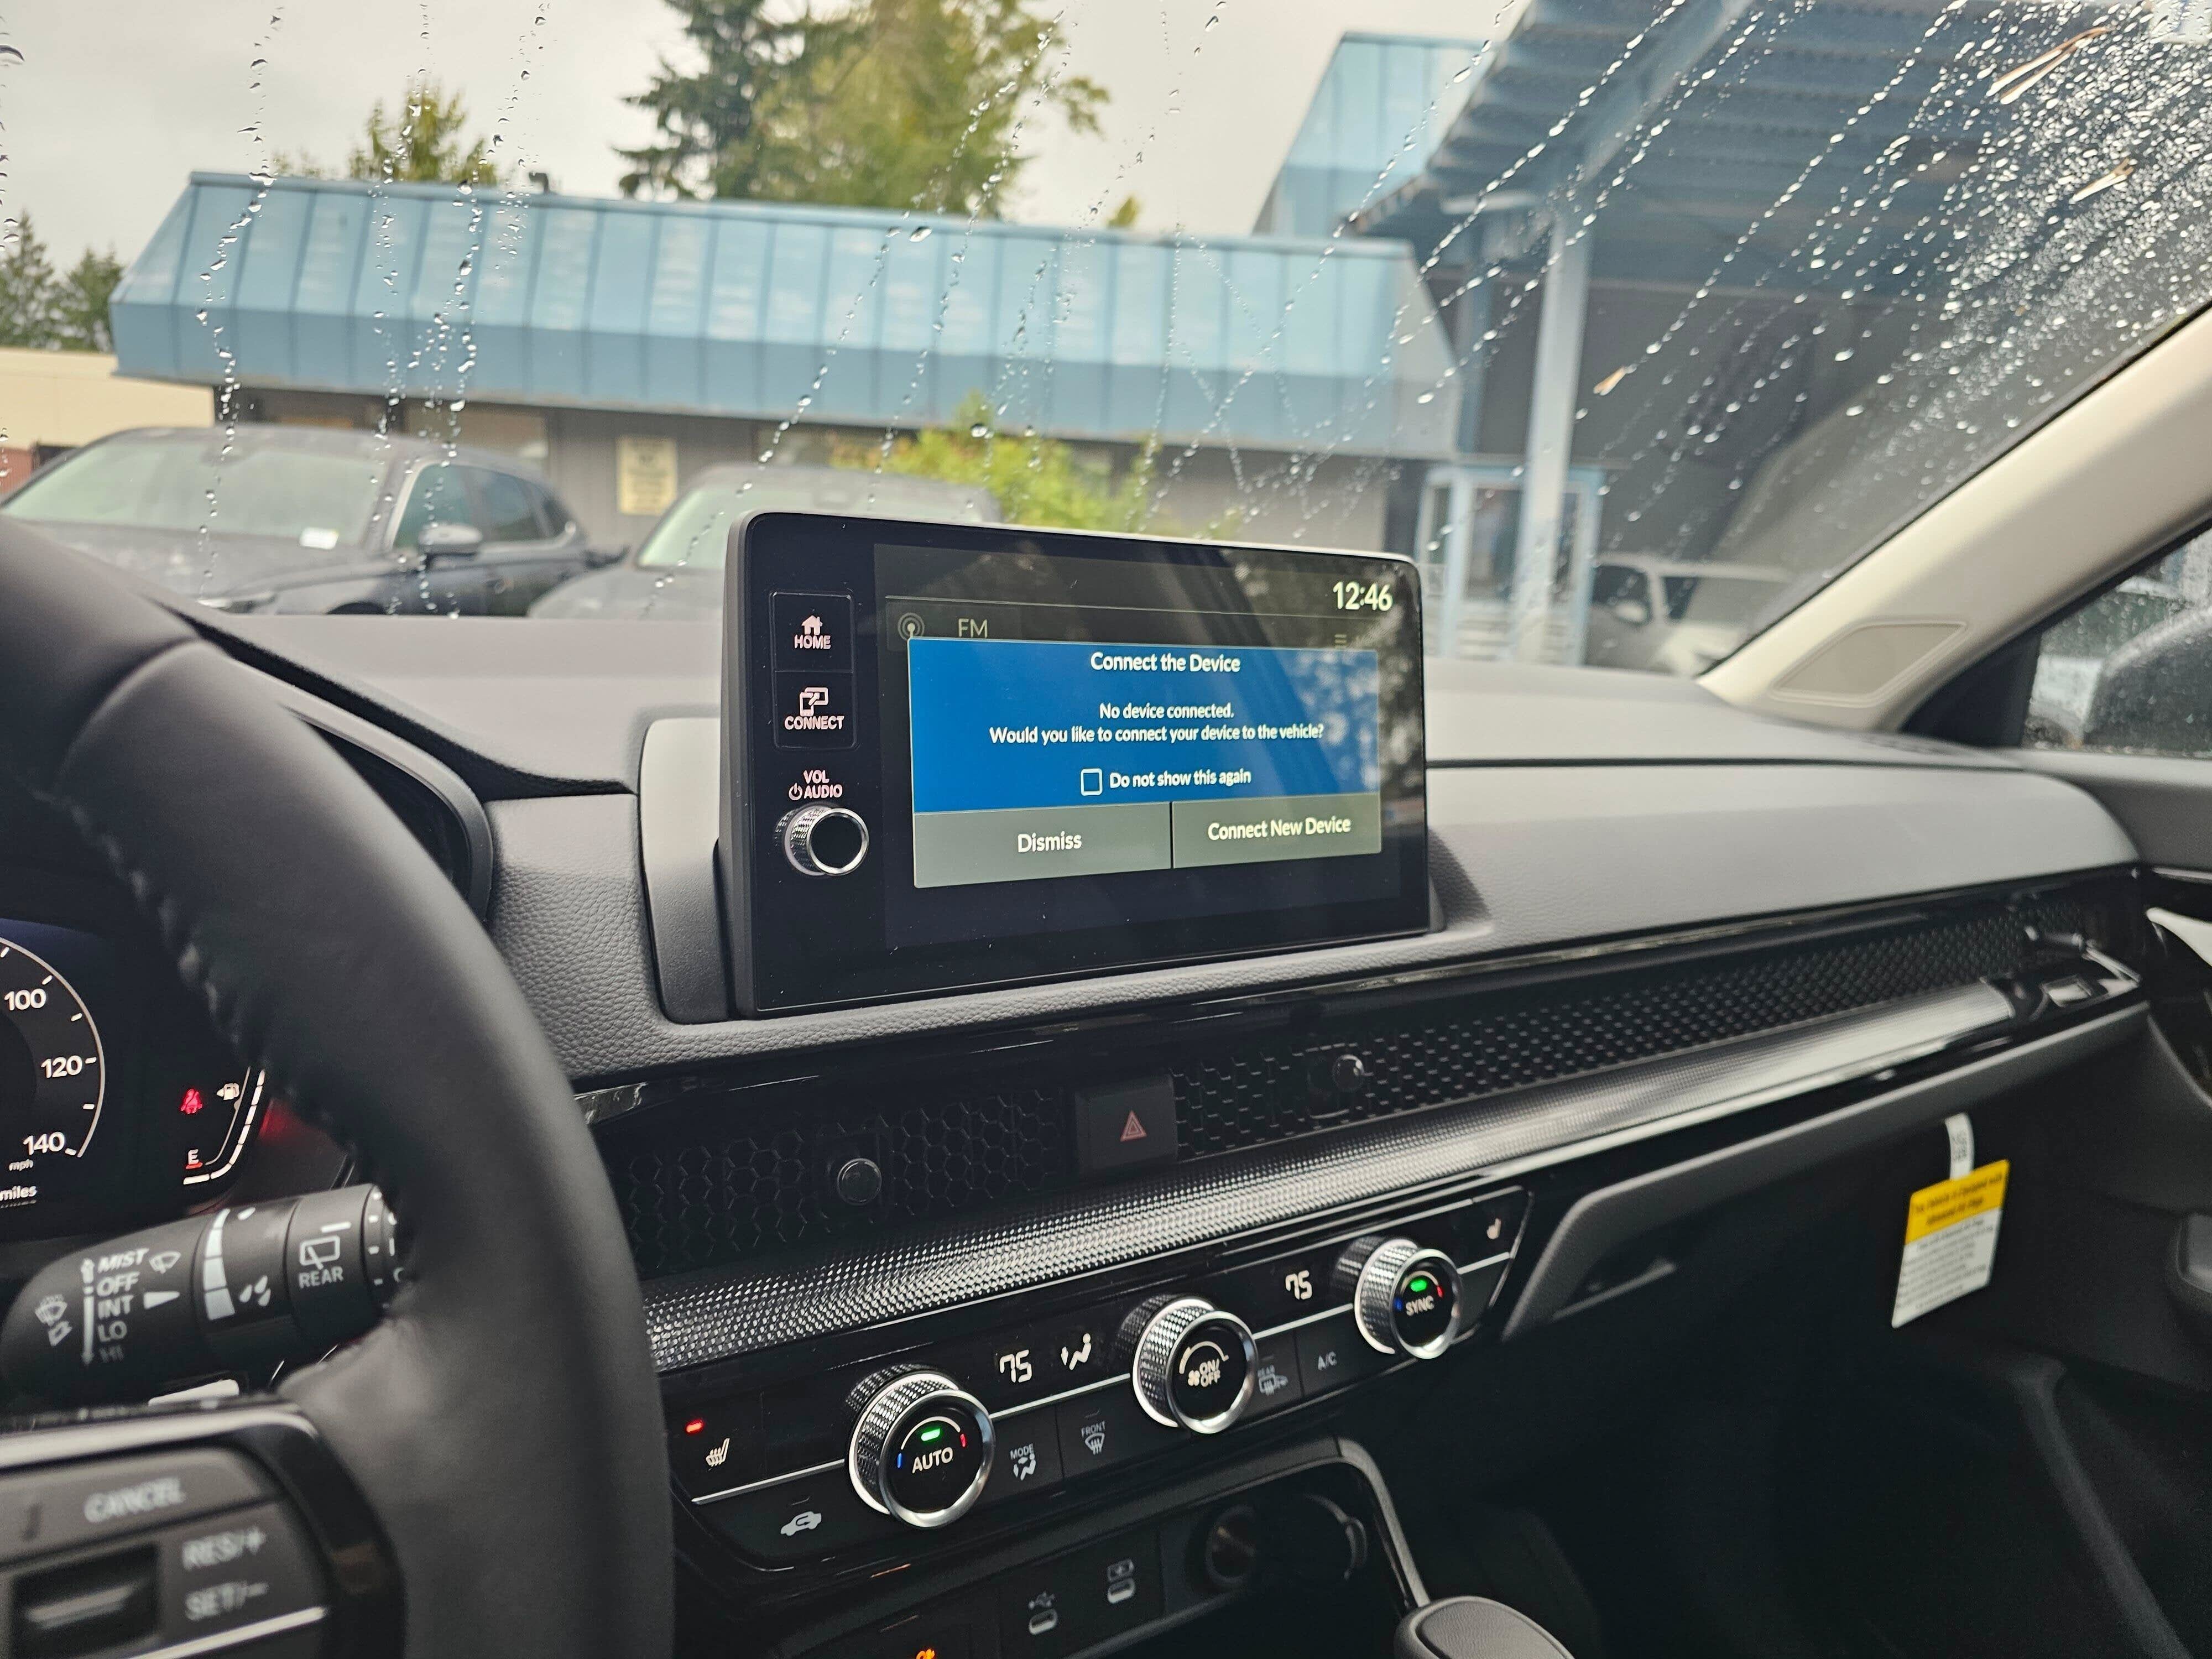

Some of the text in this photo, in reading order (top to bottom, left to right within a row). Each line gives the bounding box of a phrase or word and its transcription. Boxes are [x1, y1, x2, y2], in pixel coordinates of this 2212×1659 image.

[1333, 580, 1393, 611] 12:46
[958, 618, 988, 638] FM
[794, 635, 831, 649] HOME
[1091, 651, 1240, 672] Connect the Device
[1099, 702, 1234, 719] No device connected.
[784, 716, 844, 730] CONNECT
[989, 723, 1324, 745] Would you like to connect your device to the vehicle?
[803, 770, 830, 784] VOL
[1110, 768, 1251, 788] Do not show this again
[804, 785, 843, 799] AUDIO
[1208, 815, 1351, 841] Connect New Device
[1018, 831, 1082, 853] Dismiss
[6, 989, 46, 1010] 100
[41, 1056, 82, 1078] 120
[23, 1132, 65, 1155] 140
[9, 1159, 34, 1171] mph
[187, 1149, 200, 1164] E
[0, 1186, 37, 1201] miles
[97, 1248, 149, 1273] MIST
[97, 1272, 140, 1296] OFF
[299, 1266, 343, 1288] REAR
[1285, 1270, 1313, 1301] 75
[98, 1295, 134, 1319] INT
[1406, 1295, 1434, 1316] SYNC
[98, 1321, 127, 1342] LO
[1000, 1349, 1033, 1383] 75
[1318, 1351, 1337, 1370] A/C
[1201, 1370, 1220, 1387] OFF
[1081, 1421, 1106, 1438] FRONT
[912, 1447, 953, 1473] AUTO
[1010, 1443, 1034, 1460] MODE
